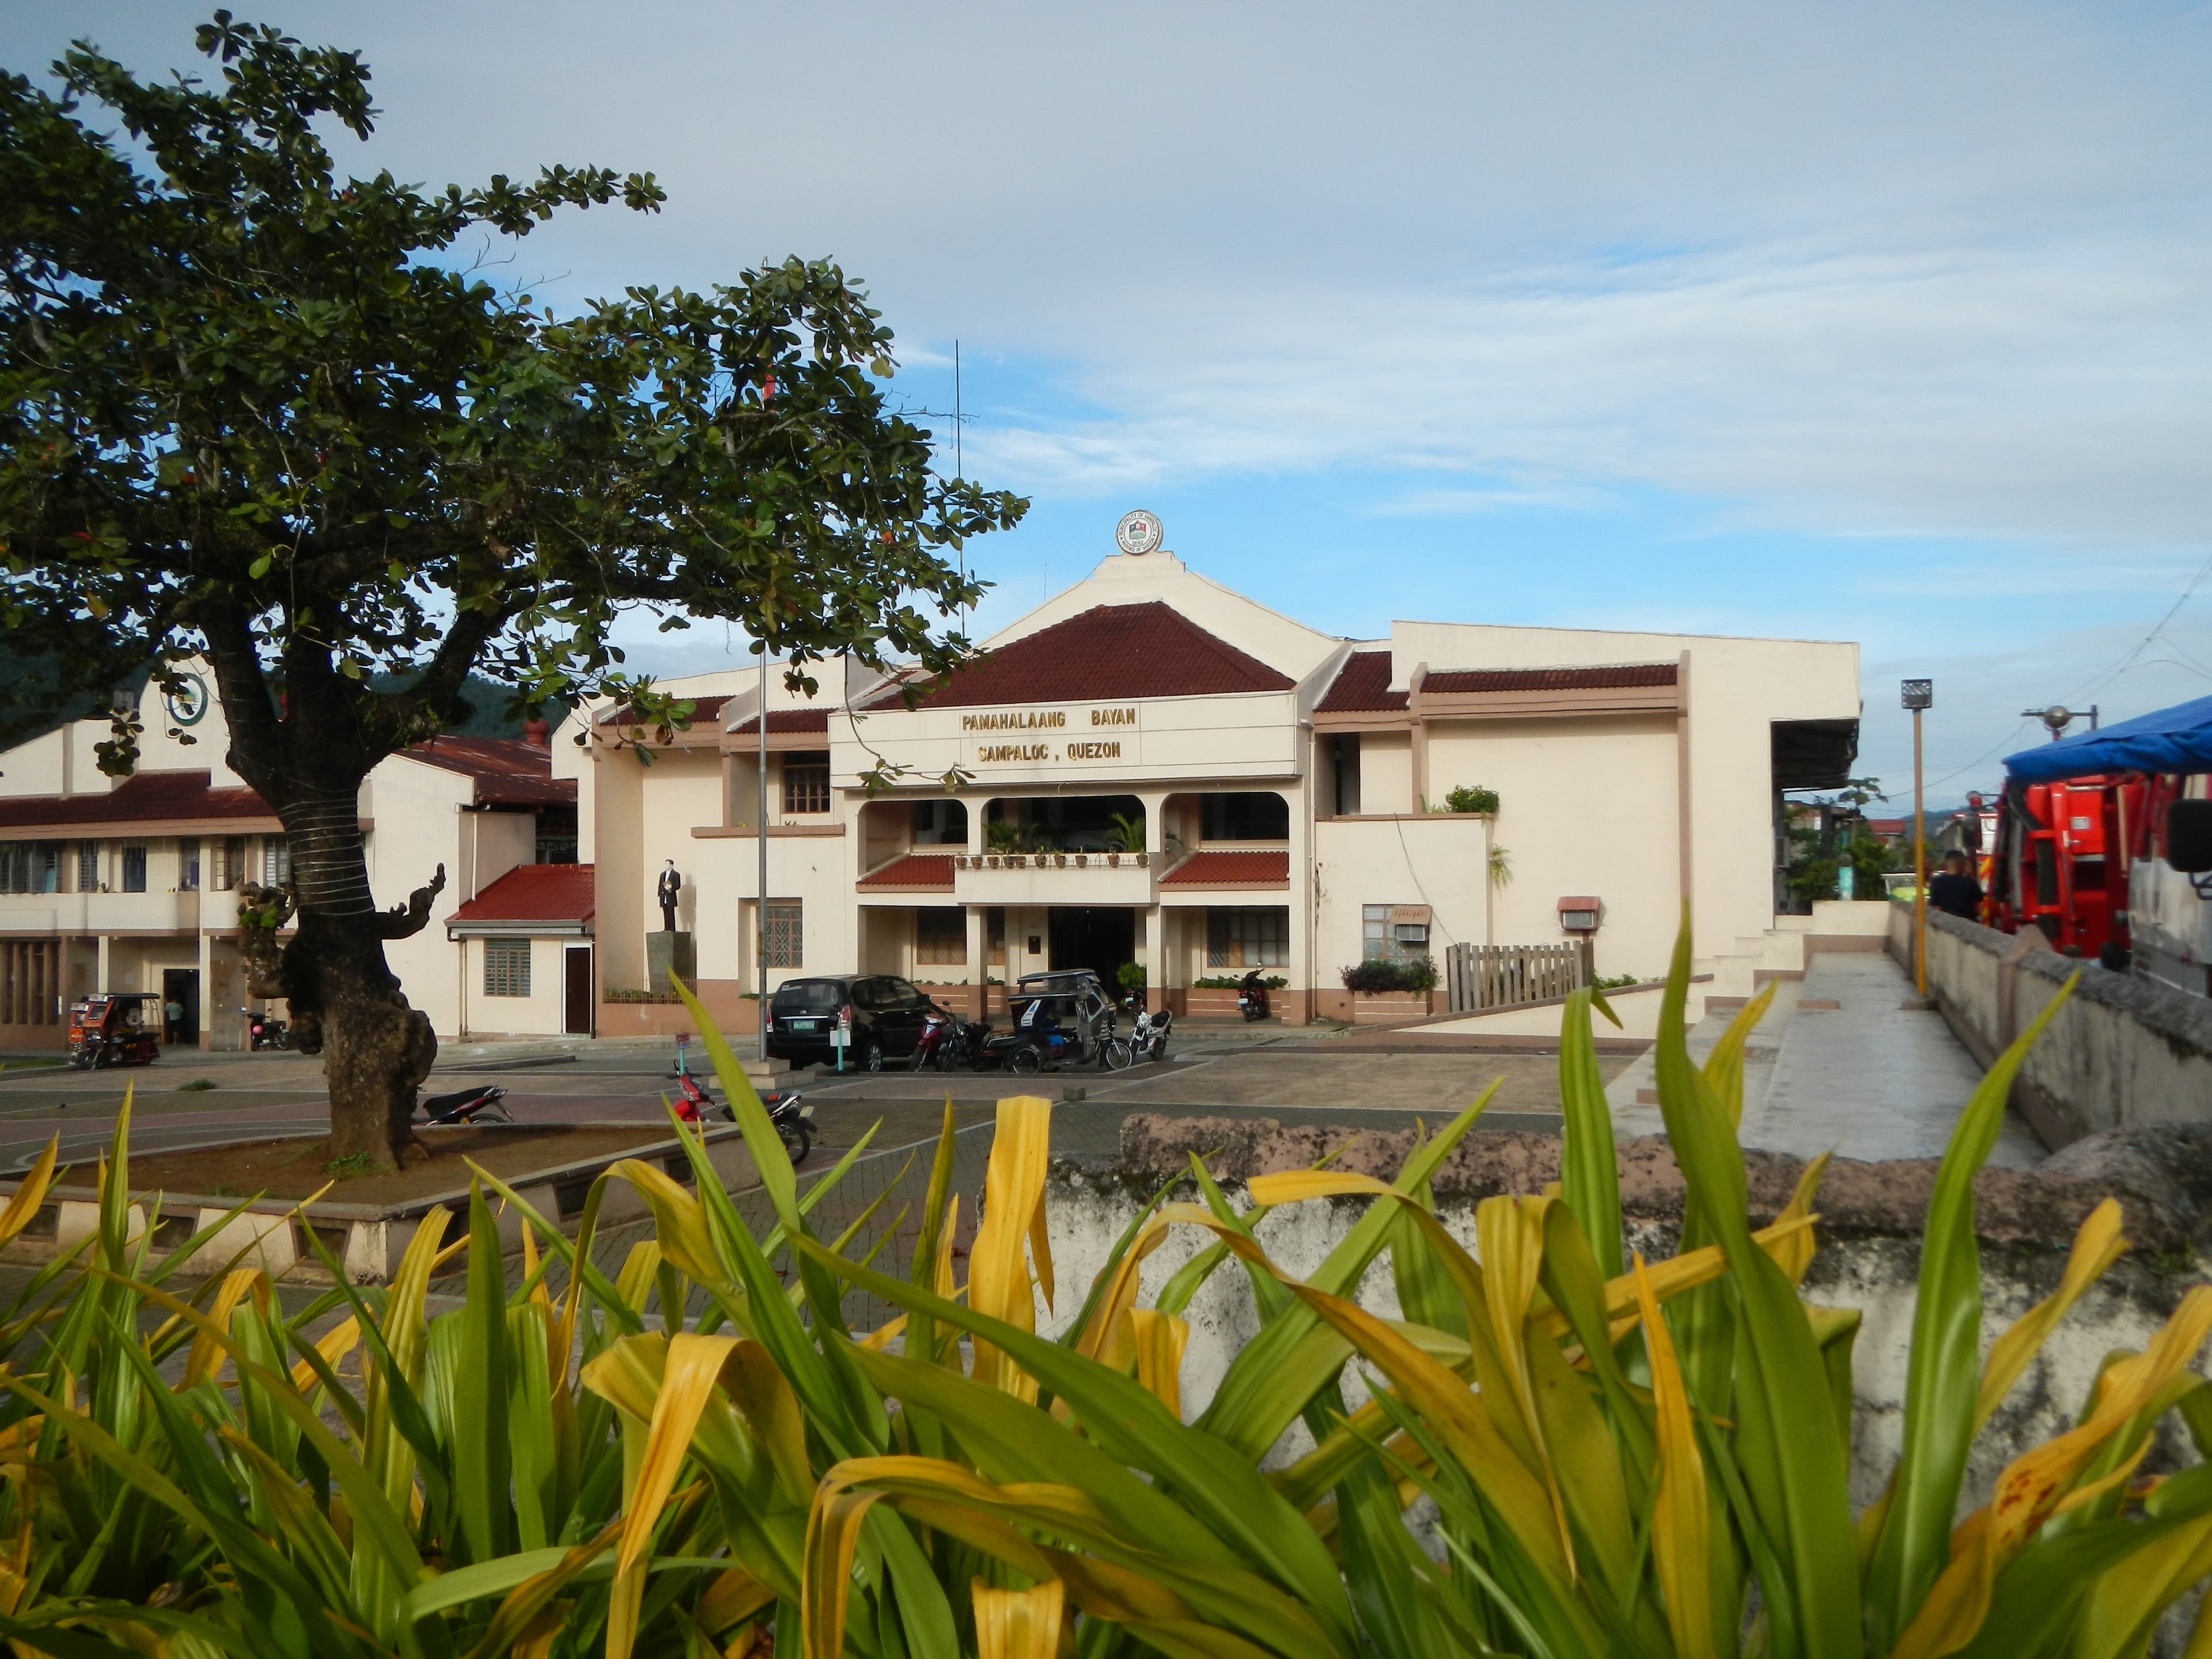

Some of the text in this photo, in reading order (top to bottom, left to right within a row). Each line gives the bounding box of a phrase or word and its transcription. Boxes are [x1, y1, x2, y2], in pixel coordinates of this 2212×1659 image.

[963, 708, 1135, 730] PAMAHALAANG BAYAN
[979, 744, 1048, 762] SAMPALOC
[1067, 742, 1120, 760] QUEZON
